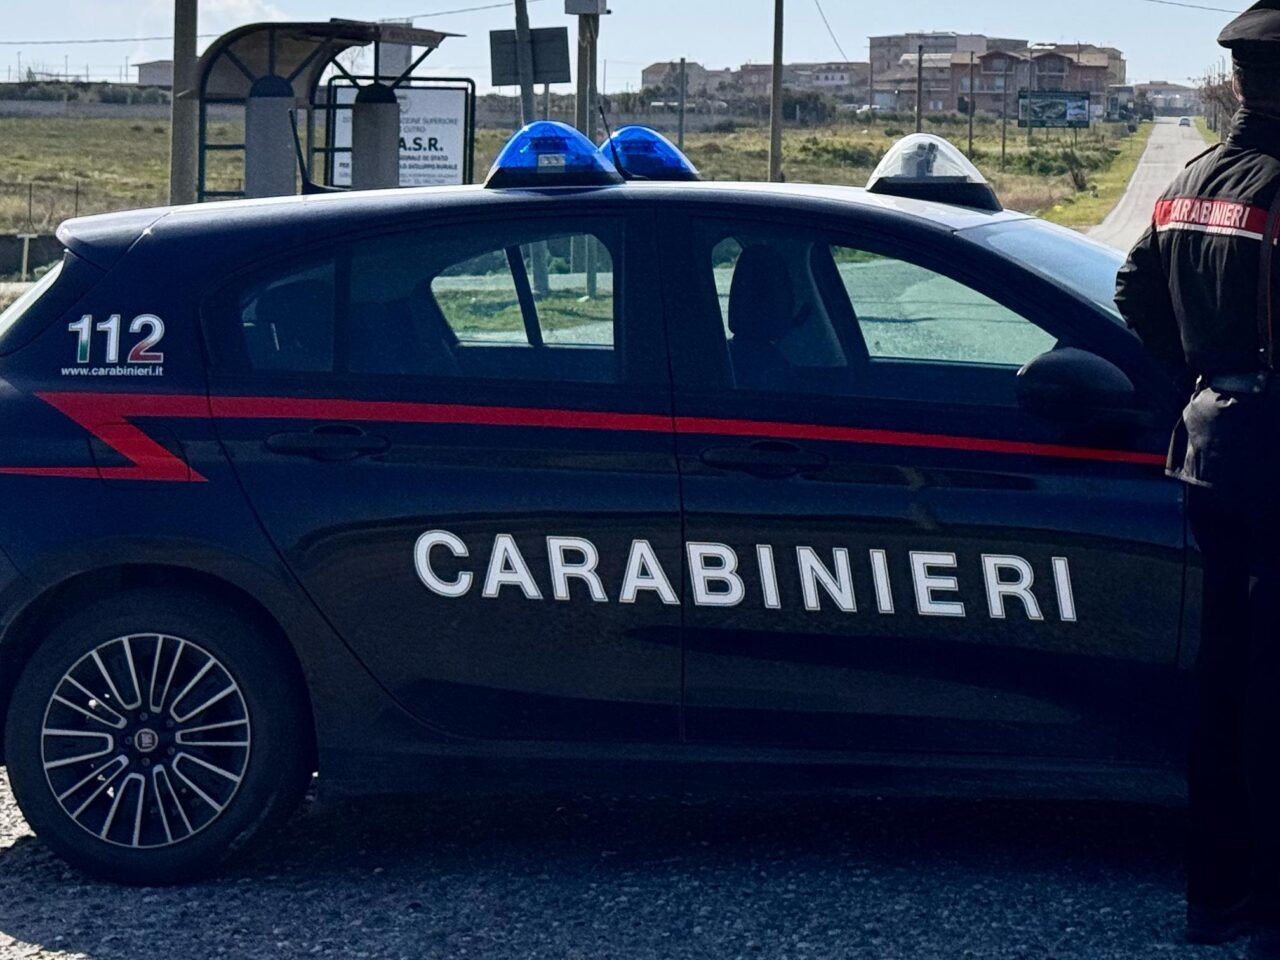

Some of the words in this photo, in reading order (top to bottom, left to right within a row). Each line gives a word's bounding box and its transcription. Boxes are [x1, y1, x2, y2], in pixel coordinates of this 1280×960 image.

[68, 313, 166, 364] 112
[61, 365, 164, 377] www.carabinieri.it
[413, 529, 1078, 622] CARABINIERI
